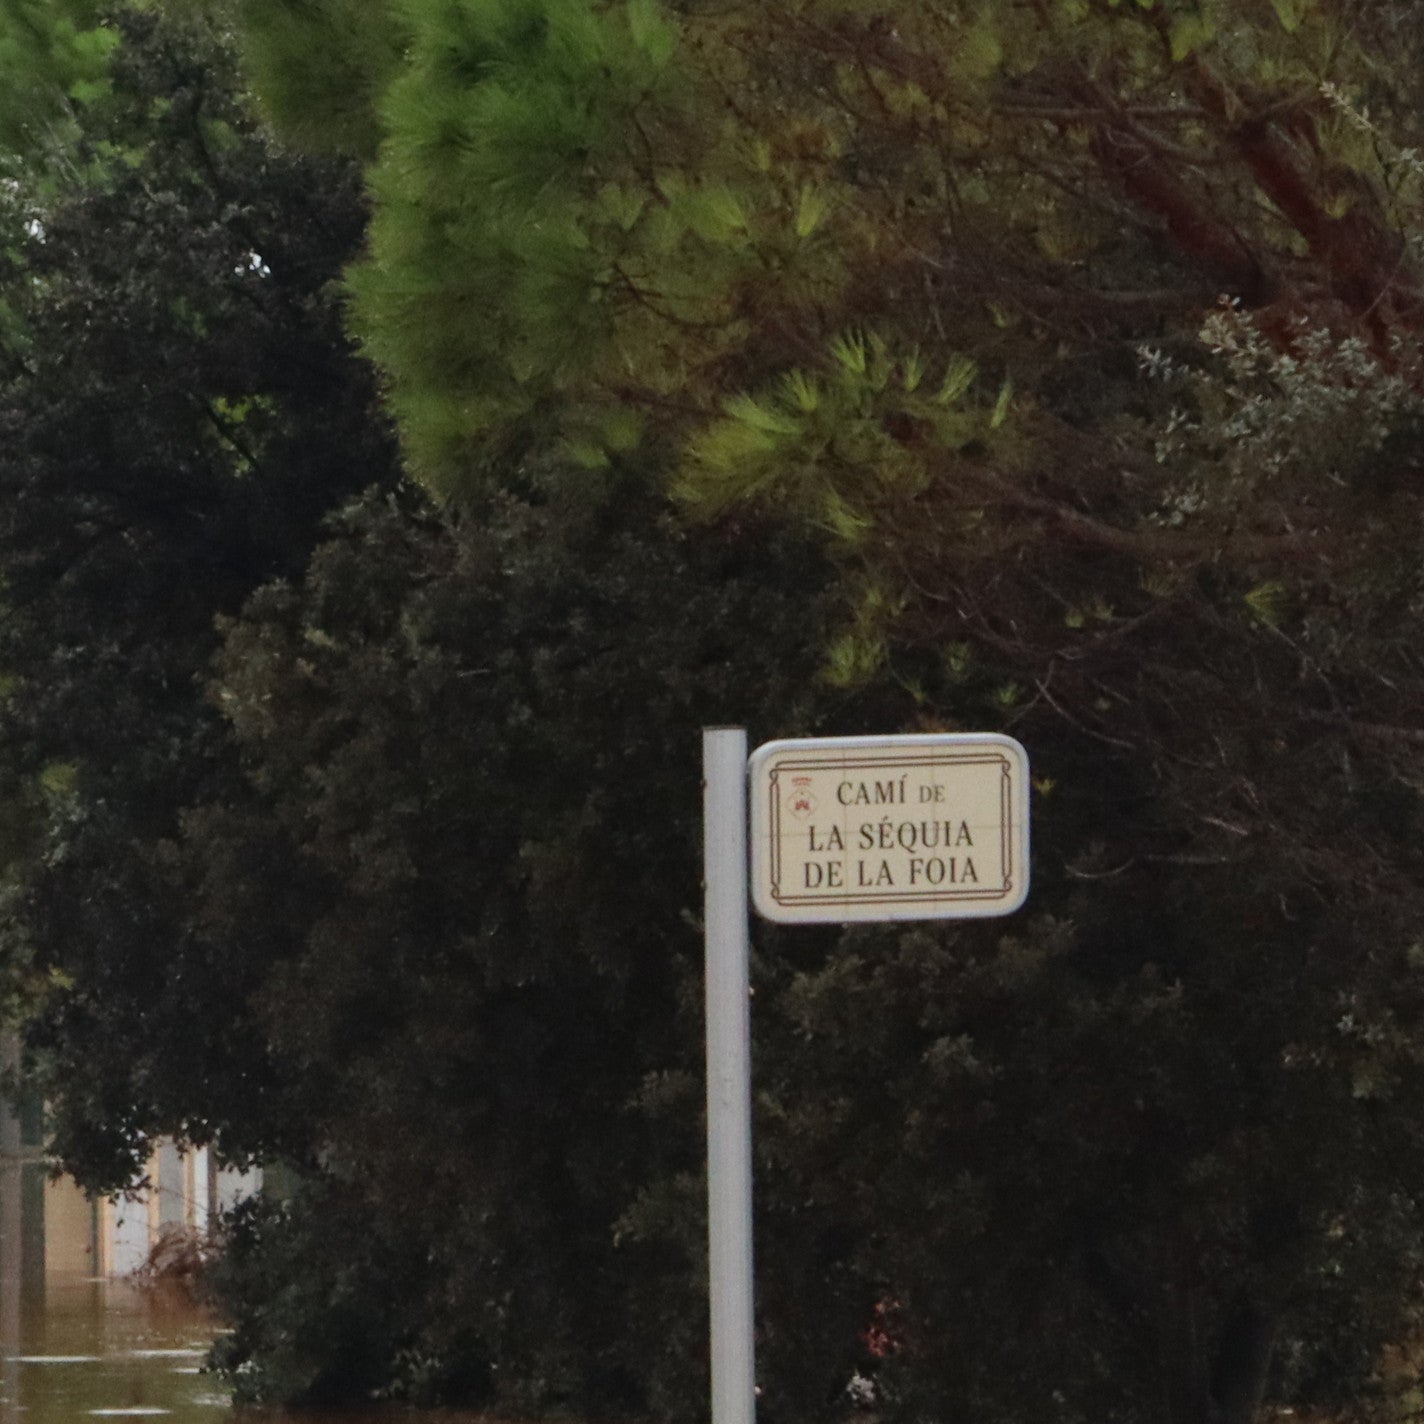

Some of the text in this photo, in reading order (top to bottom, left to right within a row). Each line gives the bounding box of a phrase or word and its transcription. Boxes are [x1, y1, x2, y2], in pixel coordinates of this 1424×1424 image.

[837, 774, 946, 805] CAMÍ DE
[808, 816, 974, 854] LA SÉQUIA
[805, 857, 979, 888] DE LA FOIA
